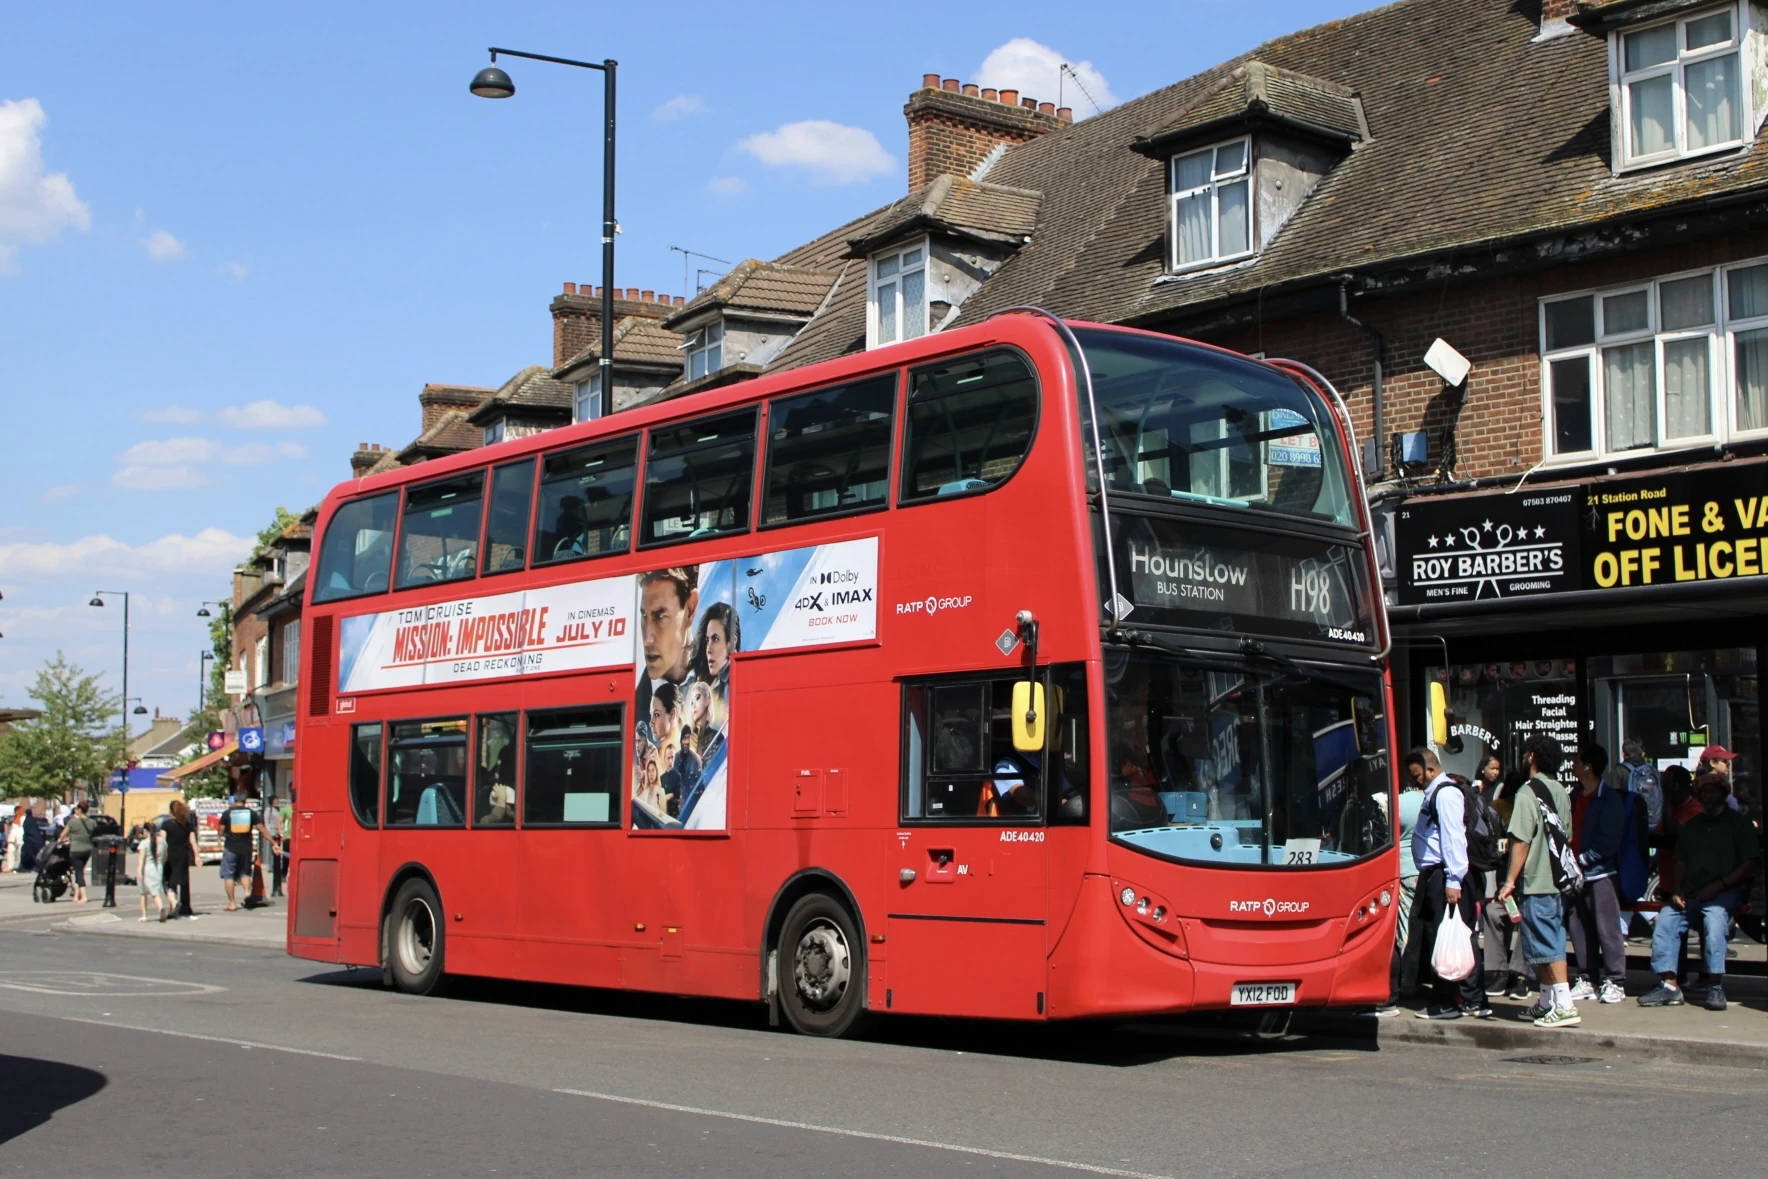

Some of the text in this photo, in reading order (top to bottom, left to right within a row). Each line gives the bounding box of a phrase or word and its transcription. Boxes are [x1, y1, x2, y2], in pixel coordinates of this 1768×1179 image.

[1272, 451, 1321, 464] 020 8998 6
[1523, 495, 1572, 507] 07503 870407
[1587, 487, 1667, 506] 21 Station Road
[1402, 511, 1410, 519] 21
[1607, 504, 1691, 543] FONE
[1702, 501, 1725, 533] &
[1131, 545, 1247, 586] Hounslow
[1413, 549, 1563, 580] ROY BARBER'S
[1594, 547, 1661, 588] OFF
[810, 570, 859, 585] IN Dolby
[1157, 581, 1224, 601] BUS STATION
[1291, 567, 1331, 614] H98
[1426, 586, 1468, 597] MEN'S FINE
[1509, 581, 1551, 591] GROOMING
[795, 588, 873, 611] 4DX & IMAX
[896, 595, 973, 614] RATP GROUP
[398, 602, 473, 624] TOM CRUISE
[567, 606, 615, 621] IN CINEMAS
[808, 613, 858, 627] BOOK NOW
[392, 606, 549, 663] MISSION: IMPOSSIBLE
[555, 618, 627, 643] JULY 10
[1328, 628, 1365, 642] ADE40420
[453, 653, 543, 674] DEAD RECKONING
[1532, 694, 1576, 706] Threading
[1541, 706, 1567, 717] Facial
[1515, 720, 1534, 730] Hair
[1450, 724, 1500, 750] BARBER'S
[1000, 831, 1045, 842] ADE40420
[1288, 851, 1313, 865] 283
[957, 864, 968, 875] AV
[1230, 901, 1310, 913] RATP GROUP
[1239, 986, 1288, 1002] YX12 FOD
